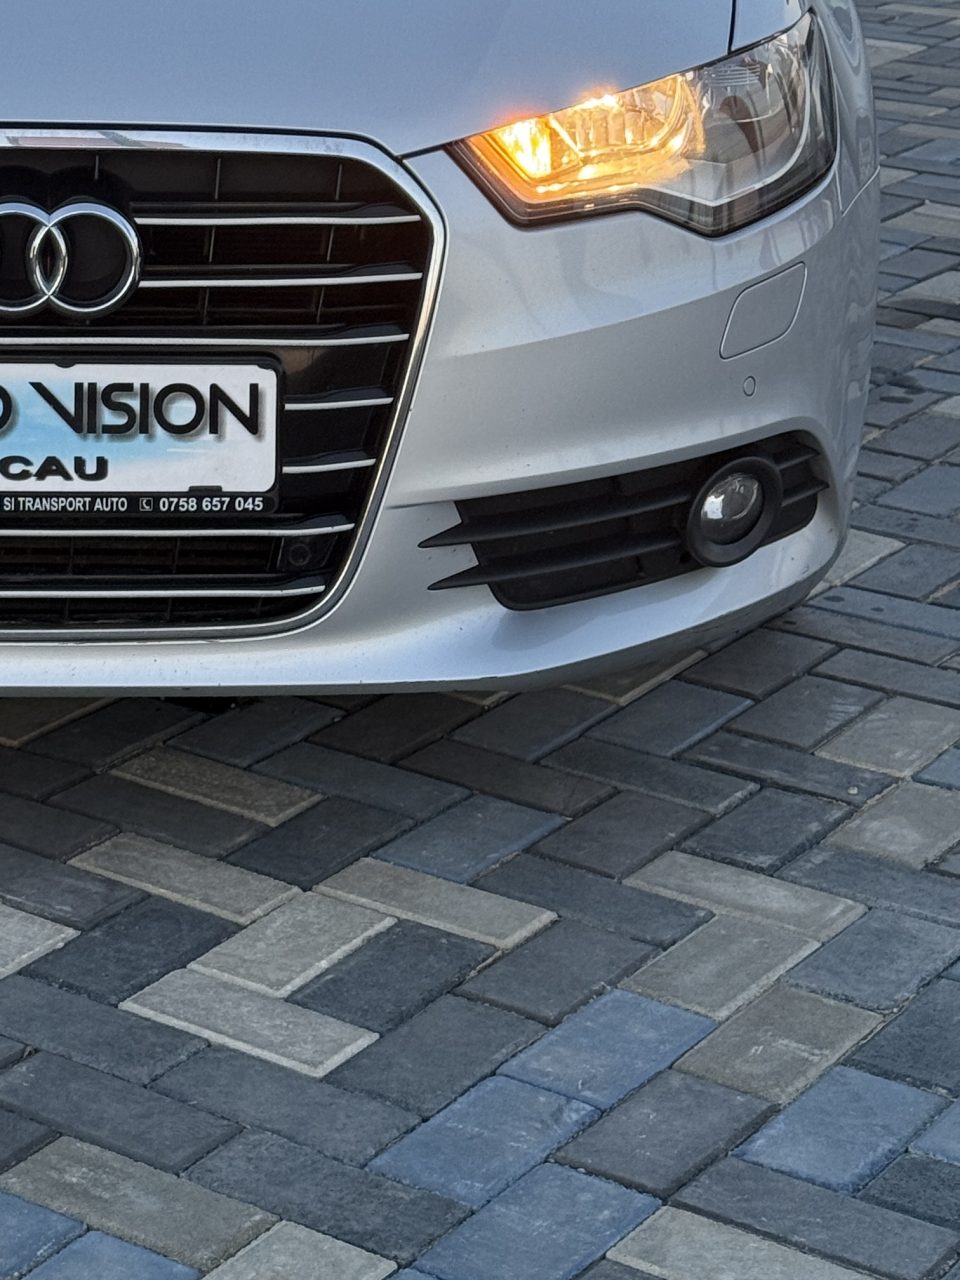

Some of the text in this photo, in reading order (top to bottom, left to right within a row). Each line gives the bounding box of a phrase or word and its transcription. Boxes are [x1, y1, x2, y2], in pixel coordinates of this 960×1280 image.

[28, 381, 259, 436] VISION
[3, 497, 15, 511] SI
[18, 497, 92, 512] TRANSPORT
[93, 497, 128, 511] AUTO
[159, 497, 198, 511] 0758
[202, 497, 230, 511] 657
[235, 497, 264, 511] 045
